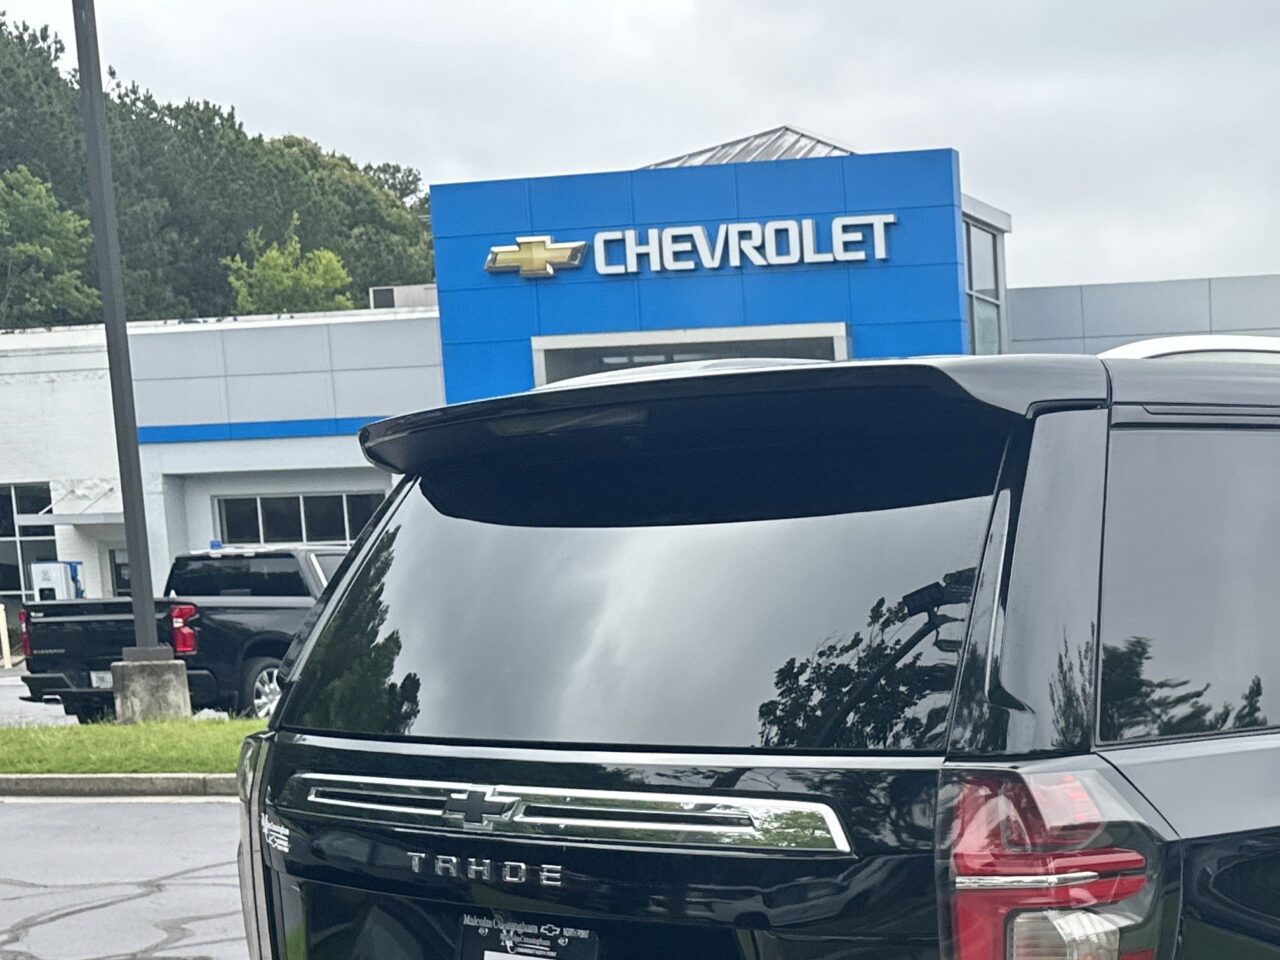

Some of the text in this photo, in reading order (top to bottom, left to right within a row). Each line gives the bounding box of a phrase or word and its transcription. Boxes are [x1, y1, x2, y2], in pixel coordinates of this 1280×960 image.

[593, 213, 897, 276] CHEVROLET
[406, 852, 563, 887] TAHOE
[463, 913, 493, 928] Malcolm
